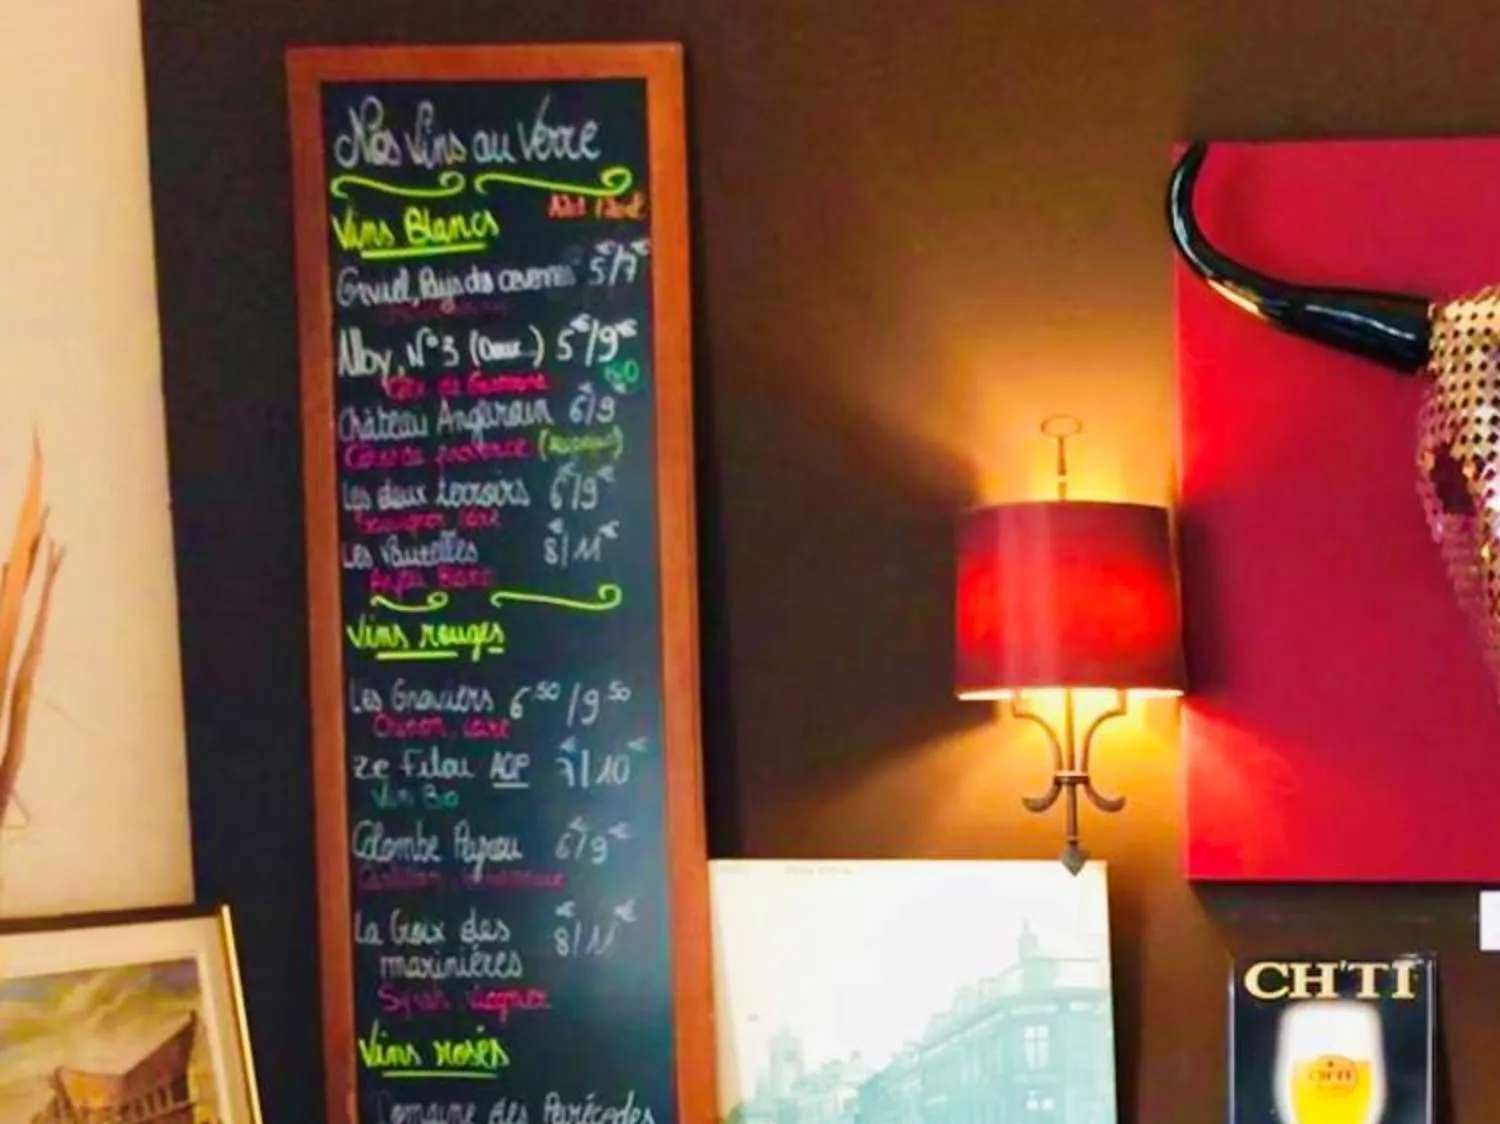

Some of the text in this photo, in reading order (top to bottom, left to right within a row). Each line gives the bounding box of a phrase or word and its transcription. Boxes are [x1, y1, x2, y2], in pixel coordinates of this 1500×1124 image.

[472, 128, 517, 163] au
[332, 204, 500, 250] Vins Blancs
[347, 614, 505, 662] Vins rouges
[460, 907, 510, 942] des
[1244, 960, 1418, 999] CH'TI
[359, 1020, 422, 1066] Vins
